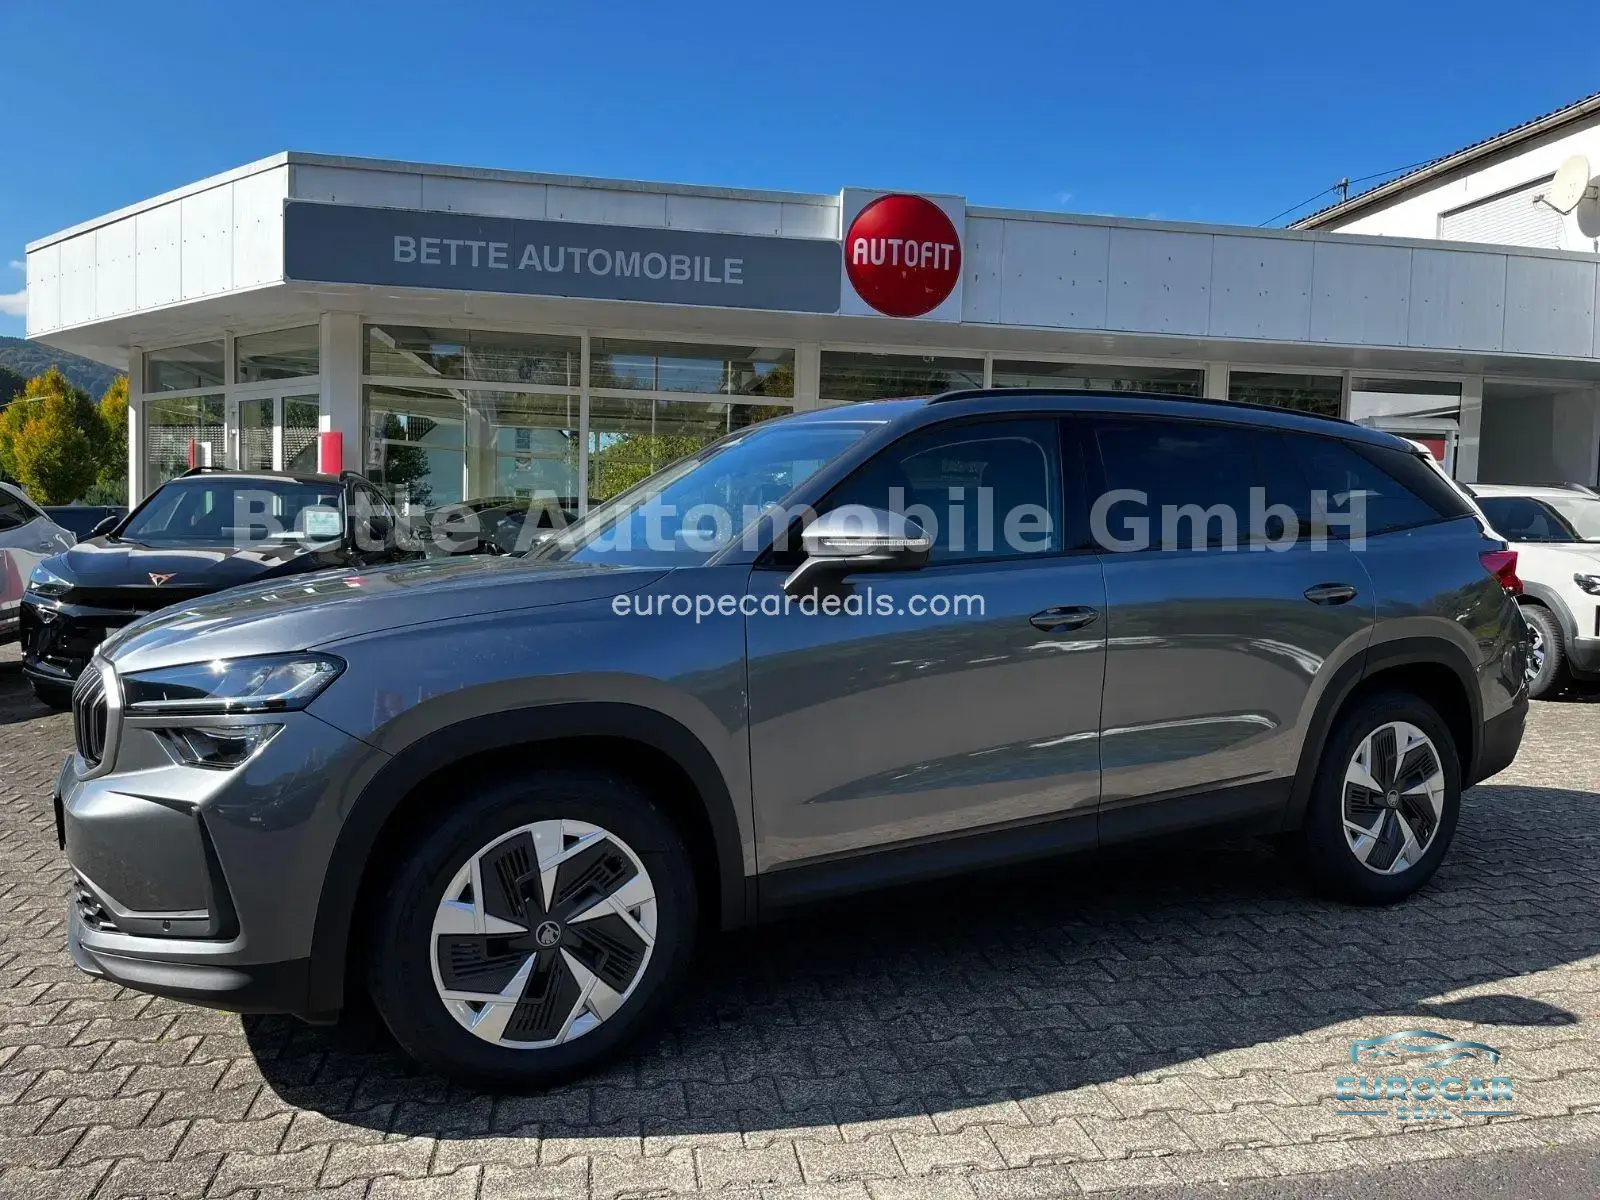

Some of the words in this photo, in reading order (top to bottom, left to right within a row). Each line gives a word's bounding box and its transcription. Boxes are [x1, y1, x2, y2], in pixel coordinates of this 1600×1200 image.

[393, 235, 509, 269] BETTE
[518, 244, 744, 285] AUTOMOBILE
[853, 237, 955, 271] AUTOFIT
